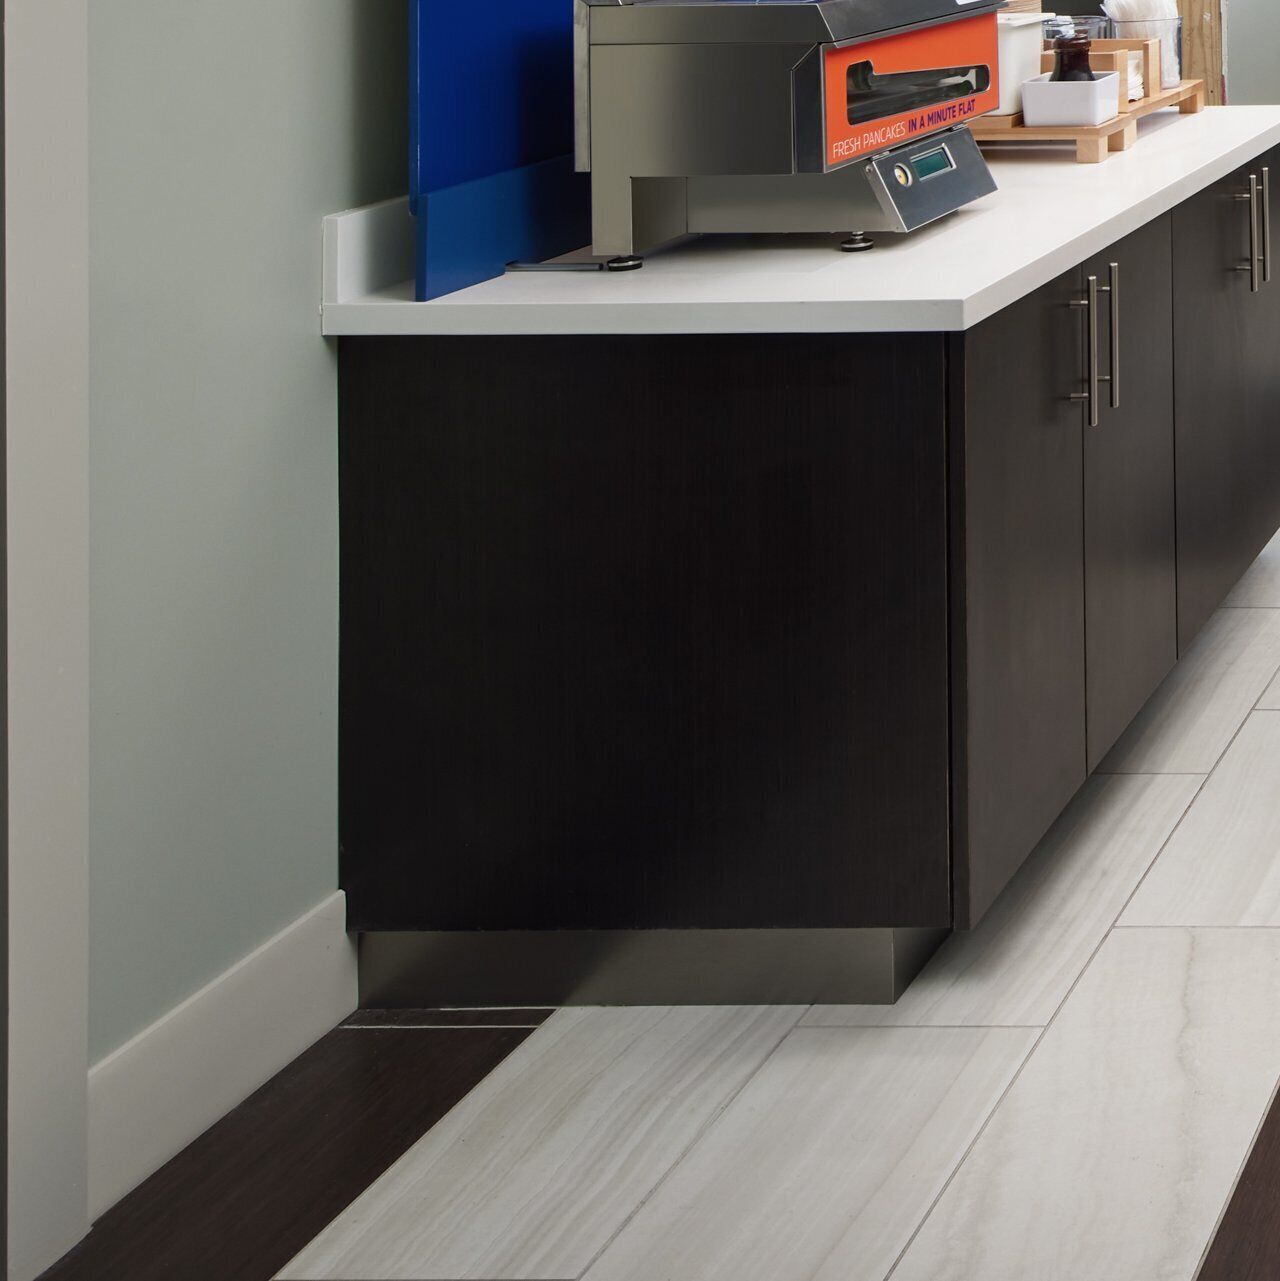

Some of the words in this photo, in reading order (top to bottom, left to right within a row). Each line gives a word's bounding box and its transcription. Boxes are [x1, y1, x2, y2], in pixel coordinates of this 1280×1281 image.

[832, 135, 861, 159] FRESH
[863, 121, 906, 149] PANCAKES
[908, 119, 918, 134] IN
[919, 117, 926, 129] A
[927, 105, 957, 127] MINUTE
[958, 98, 976, 116] FLAT
